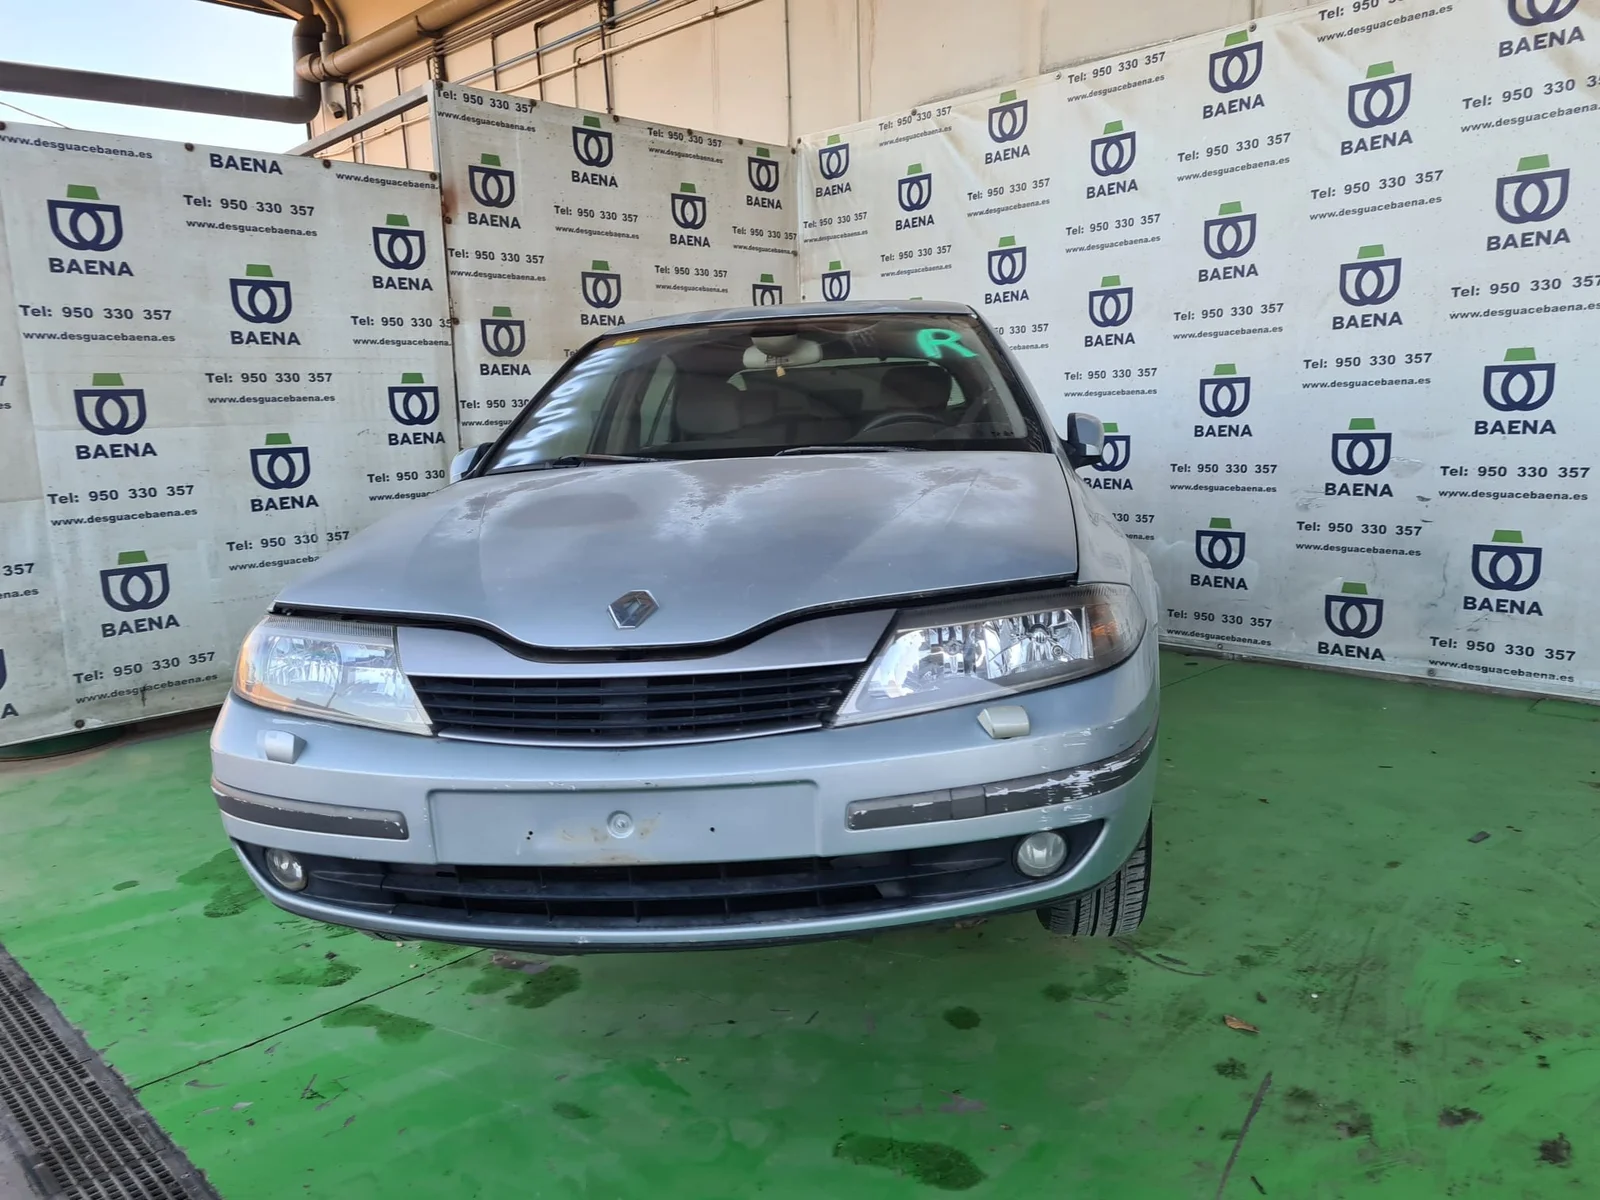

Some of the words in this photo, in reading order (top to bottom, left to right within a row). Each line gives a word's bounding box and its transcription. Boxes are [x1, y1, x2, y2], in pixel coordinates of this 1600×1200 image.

[1318, 6, 1344, 21] Tel:
[1317, 4, 1453, 43] www.desguacebaena.es
[1499, 26, 1585, 57] BAENA
[1068, 72, 1086, 84] Tel:
[1092, 65, 1112, 78] 950
[1118, 59, 1138, 72] 330
[1145, 51, 1165, 65] 357
[1068, 73, 1164, 102] www.desguacebaena.es
[1462, 95, 1492, 109] Tel:
[1502, 87, 1533, 102] 950
[1544, 79, 1575, 95] 330
[463, 93, 483, 105] 950
[490, 98, 509, 110] 330
[516, 103, 534, 114] 357
[1203, 94, 1265, 119] BAENA
[438, 110, 536, 132] www.desguacebaena.es
[879, 121, 893, 131] Tel:
[897, 115, 912, 126] 950
[917, 110, 932, 120] 330
[936, 106, 952, 117] 357
[1461, 104, 1600, 132] www.desguacebaena.
[647, 127, 664, 138] Tel:
[668, 130, 684, 141] 950
[688, 134, 703, 144] 330
[706, 138, 722, 148] 357
[878, 125, 952, 147] www.desguacebaena.es
[1341, 130, 1413, 156] BAENA
[648, 147, 724, 164] www.desguacebaena.es
[985, 145, 1030, 164] BAENA
[1178, 151, 1199, 162] Tel:
[1206, 144, 1228, 157] 950
[1236, 139, 1259, 151] 330
[1267, 132, 1290, 146] 357
[209, 153, 283, 175] BAENA
[1177, 157, 1289, 181] www.desguacebaena.es
[336, 172, 440, 190] www.desguacebaena.
[571, 170, 618, 188] BAENA
[1311, 187, 1335, 199] Tel:
[1344, 182, 1370, 194] 950
[1379, 176, 1405, 189] 330
[1415, 170, 1443, 184] 357
[816, 182, 852, 197] BAENA
[1087, 179, 1138, 199] BAENA
[183, 195, 212, 207] Tel:
[220, 198, 248, 210] 950
[256, 202, 282, 213] 330
[290, 205, 314, 216] 357
[746, 195, 782, 210] BAENA
[967, 199, 1049, 217] www.desguacebaena.es
[1310, 197, 1442, 220] www.desguacebaena.es
[186, 221, 317, 236] www.desguacebaena.es
[468, 212, 521, 229] BAENA
[804, 220, 817, 229] Tel:
[820, 217, 832, 227] 950
[838, 215, 850, 224] 330
[854, 212, 867, 221] 357
[896, 214, 935, 231] BAENA
[670, 234, 710, 248] BAENA
[804, 230, 868, 243] www.desguacebaena.es
[1066, 236, 1160, 253] www.desguacebaena.es
[1487, 228, 1570, 251] BAENA
[448, 248, 469, 259] Tel:
[475, 250, 495, 260] 950
[501, 252, 520, 262] 330
[526, 254, 544, 264] 357
[48, 258, 134, 276] BAENA
[654, 265, 670, 274] Tel:
[674, 267, 690, 275] 950
[694, 268, 709, 276] 330
[714, 269, 727, 278] 357
[1199, 264, 1258, 282] BAENA
[372, 276, 433, 291] BAENA
[450, 269, 546, 283] www.desguacebaena.es
[1451, 286, 1480, 297] Tel:
[1490, 282, 1520, 294] 950
[1530, 278, 1561, 291] 330
[1572, 275, 1600, 288] 357
[985, 289, 1029, 304] BAENA
[1174, 311, 1194, 321] Tel:
[1202, 308, 1223, 319] 950
[1231, 306, 1253, 316] 330
[1261, 303, 1284, 314] 357
[1449, 303, 1600, 319] www.desguacebaena.es
[350, 316, 374, 326] Tel:
[381, 317, 404, 327] 950
[411, 318, 432, 327] 330
[581, 314, 625, 326] BAENA
[1010, 325, 1026, 334] 330
[1032, 323, 1048, 332] 357
[1332, 312, 1403, 330] BAENA
[23, 332, 175, 342] www.desguacebaena.es
[230, 331, 301, 345] BAENA
[353, 337, 452, 347] www.desguacebaena.
[916, 328, 978, 359] R
[1085, 332, 1135, 347] BAENA
[480, 363, 531, 375] BAENA
[1064, 372, 1082, 380] Tel:
[1088, 370, 1106, 379] 950
[1113, 369, 1131, 378] 330
[1138, 368, 1157, 377] 357
[208, 395, 335, 404] www.desguacebaena.es
[1064, 389, 1157, 397] www.desguacebaena.es
[460, 400, 480, 408] Tel:
[486, 400, 506, 408] 950
[1194, 424, 1253, 437] BAENA
[1474, 420, 1556, 435] BAENA
[388, 432, 446, 446] BAENA
[75, 443, 158, 460] BAENA
[367, 473, 390, 483] Tel:
[396, 471, 418, 481] 950
[425, 470, 445, 480] 330
[47, 493, 79, 504] Tel:
[88, 490, 119, 502] 950
[128, 487, 157, 499] 330
[166, 485, 194, 496] 357
[1170, 484, 1276, 492] www.desguacebaena.es
[1324, 483, 1393, 497] BAENA
[1439, 490, 1588, 500] www.desguacebaena.es
[250, 495, 319, 512] BAENA
[51, 509, 197, 526] www.desguacebaena.es
[1135, 514, 1155, 523] 357
[1296, 521, 1320, 531] Tel:
[1328, 523, 1353, 533] 950
[1361, 524, 1387, 534] 330
[1395, 525, 1422, 536] 357
[226, 540, 253, 551] Tel:
[260, 537, 286, 548] 950
[294, 534, 318, 545] 330
[326, 531, 349, 542] 357
[1296, 544, 1421, 556] www.desguacebaena.es
[3, 562, 36, 576] 357
[1190, 574, 1248, 590] BAENA
[1463, 596, 1543, 616] BAENA
[101, 614, 180, 638] BAENA
[1167, 609, 1187, 619] Tel:
[1194, 612, 1215, 622] 950
[1222, 614, 1243, 625] 330
[1250, 617, 1272, 628] 357
[1318, 641, 1386, 661] BAENA
[1430, 636, 1457, 648] Tel:
[1467, 640, 1495, 652] 950
[1505, 644, 1535, 657] 330
[1545, 648, 1576, 661] 357
[72, 670, 103, 684] Tel:
[113, 663, 142, 676] 950
[152, 657, 180, 670] 330
[189, 652, 215, 664] 357
